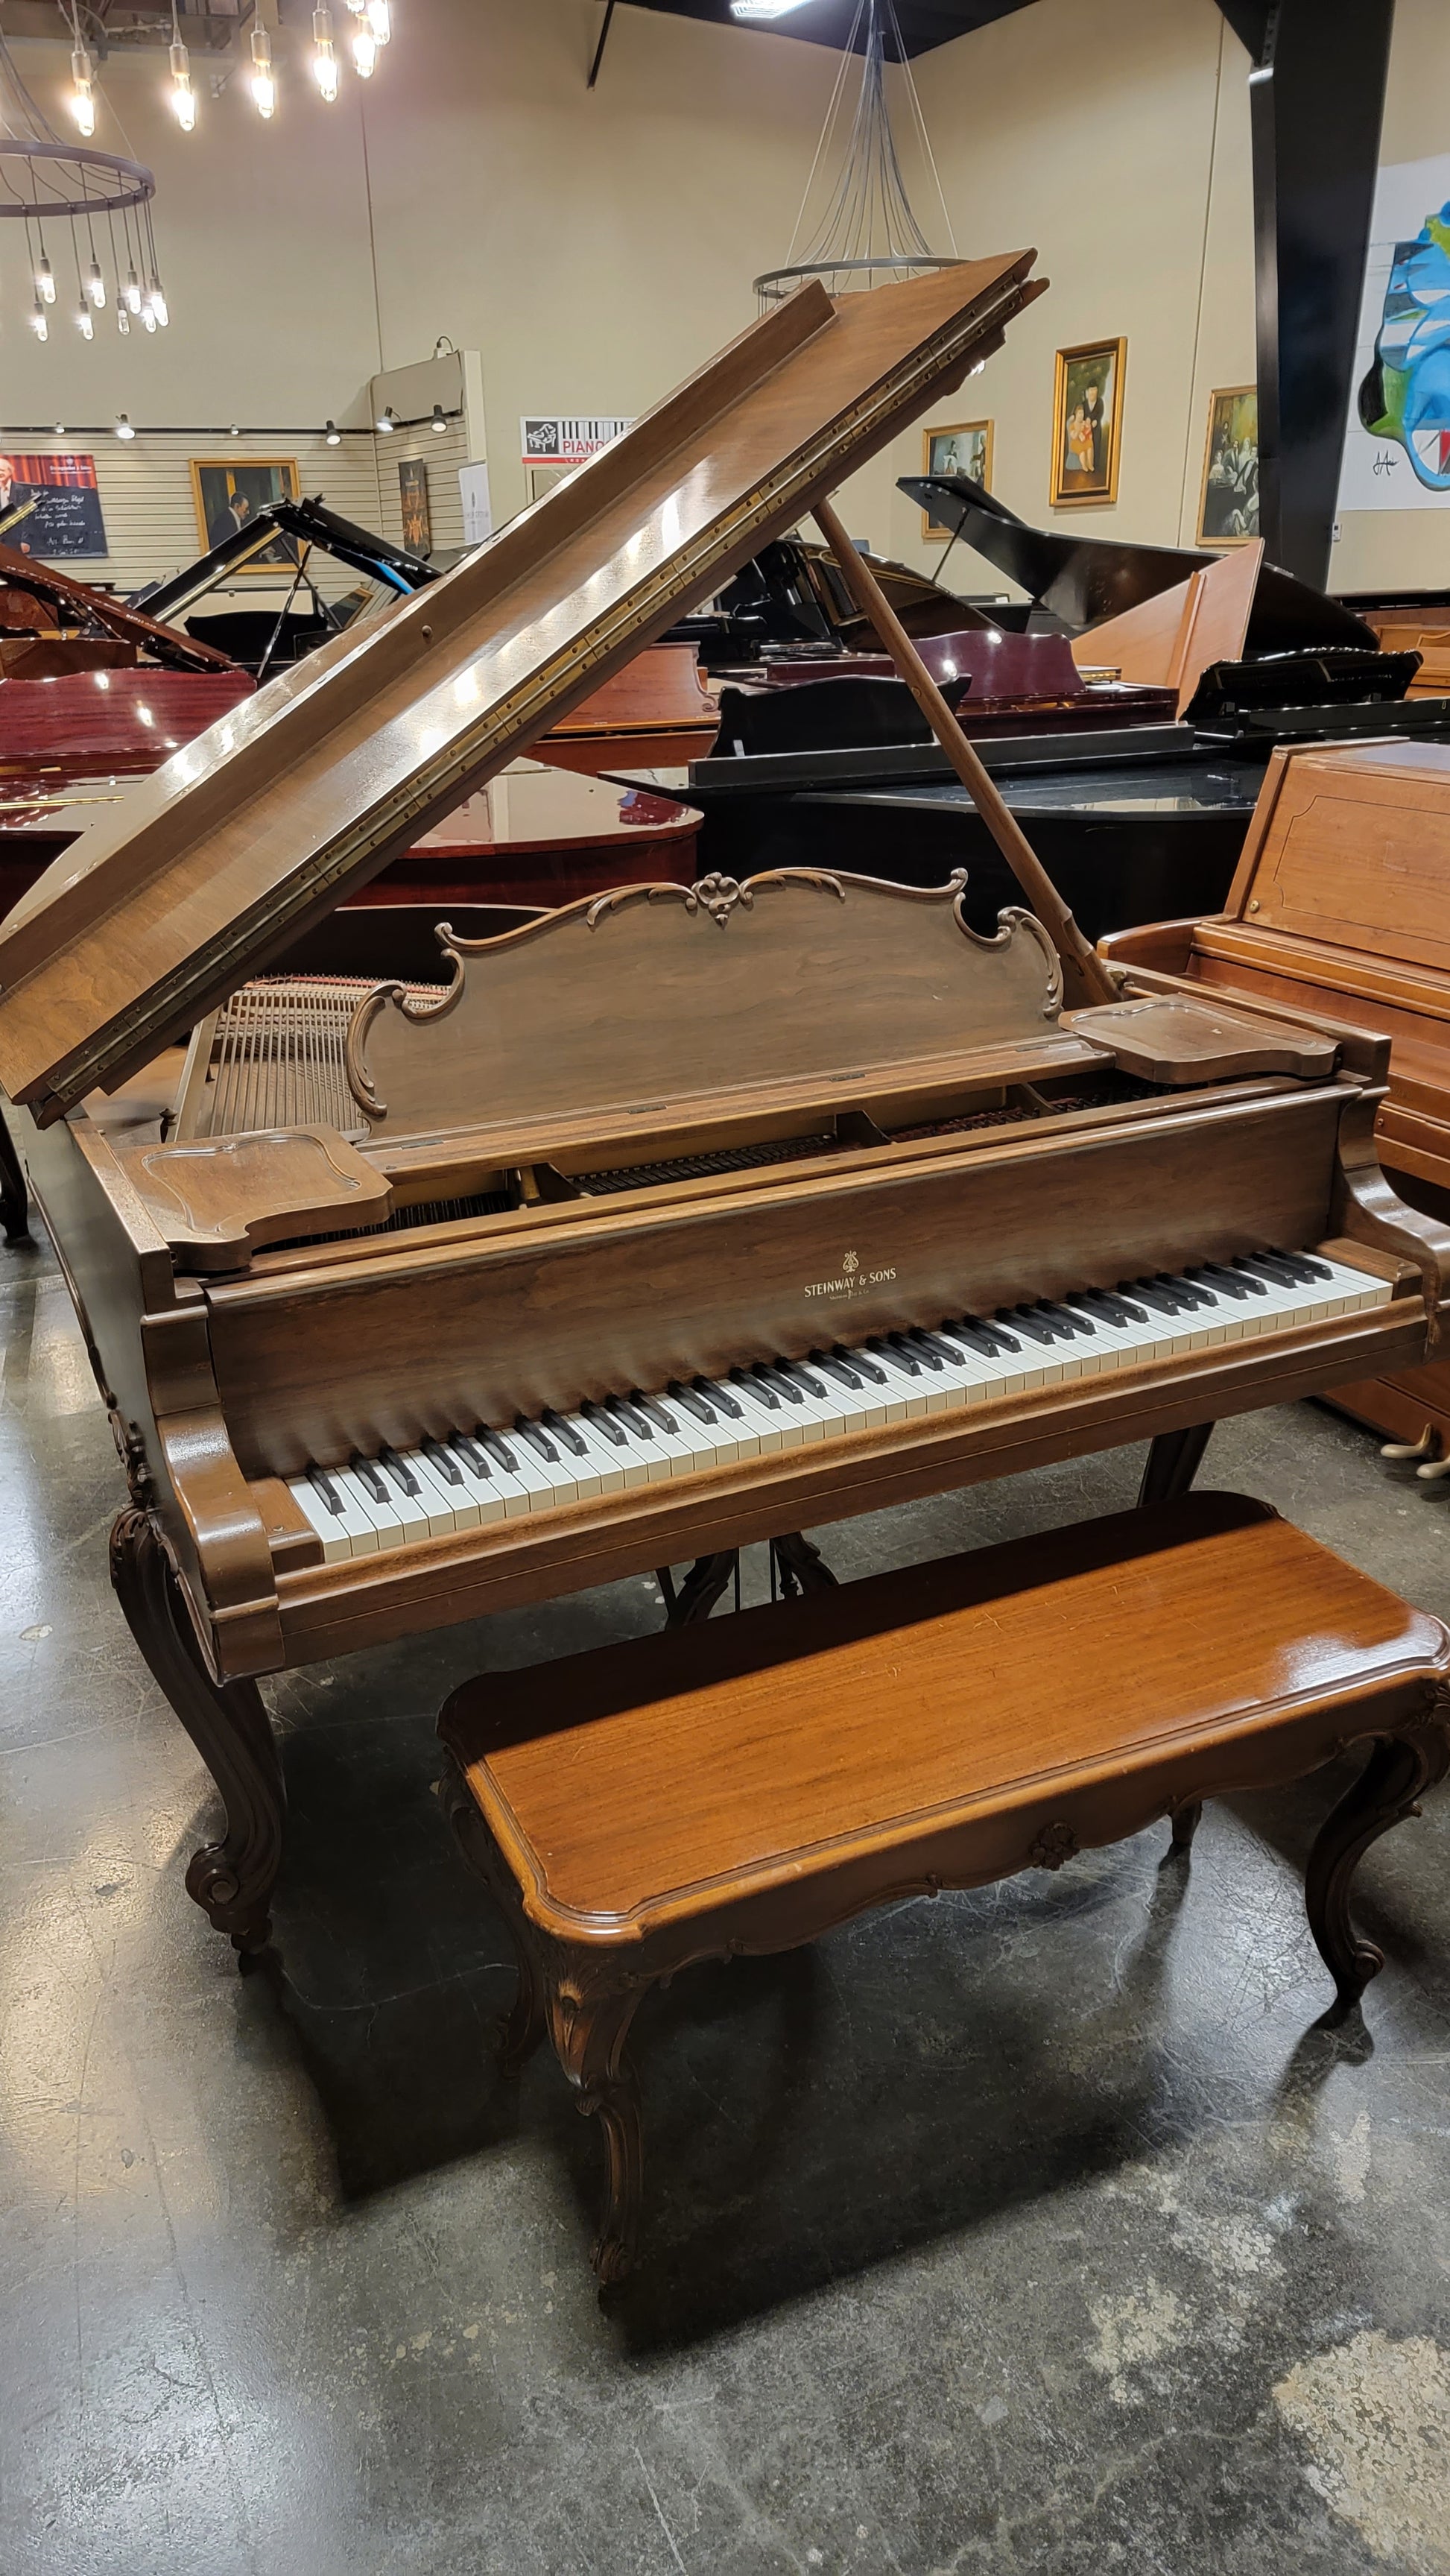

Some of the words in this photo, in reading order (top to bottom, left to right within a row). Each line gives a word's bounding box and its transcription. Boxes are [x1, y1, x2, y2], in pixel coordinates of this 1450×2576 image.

[563, 441, 611, 453] PIANO
[804, 1276, 855, 1298] STEINWAY
[859, 1275, 867, 1286] &
[869, 1268, 896, 1284] SONS
